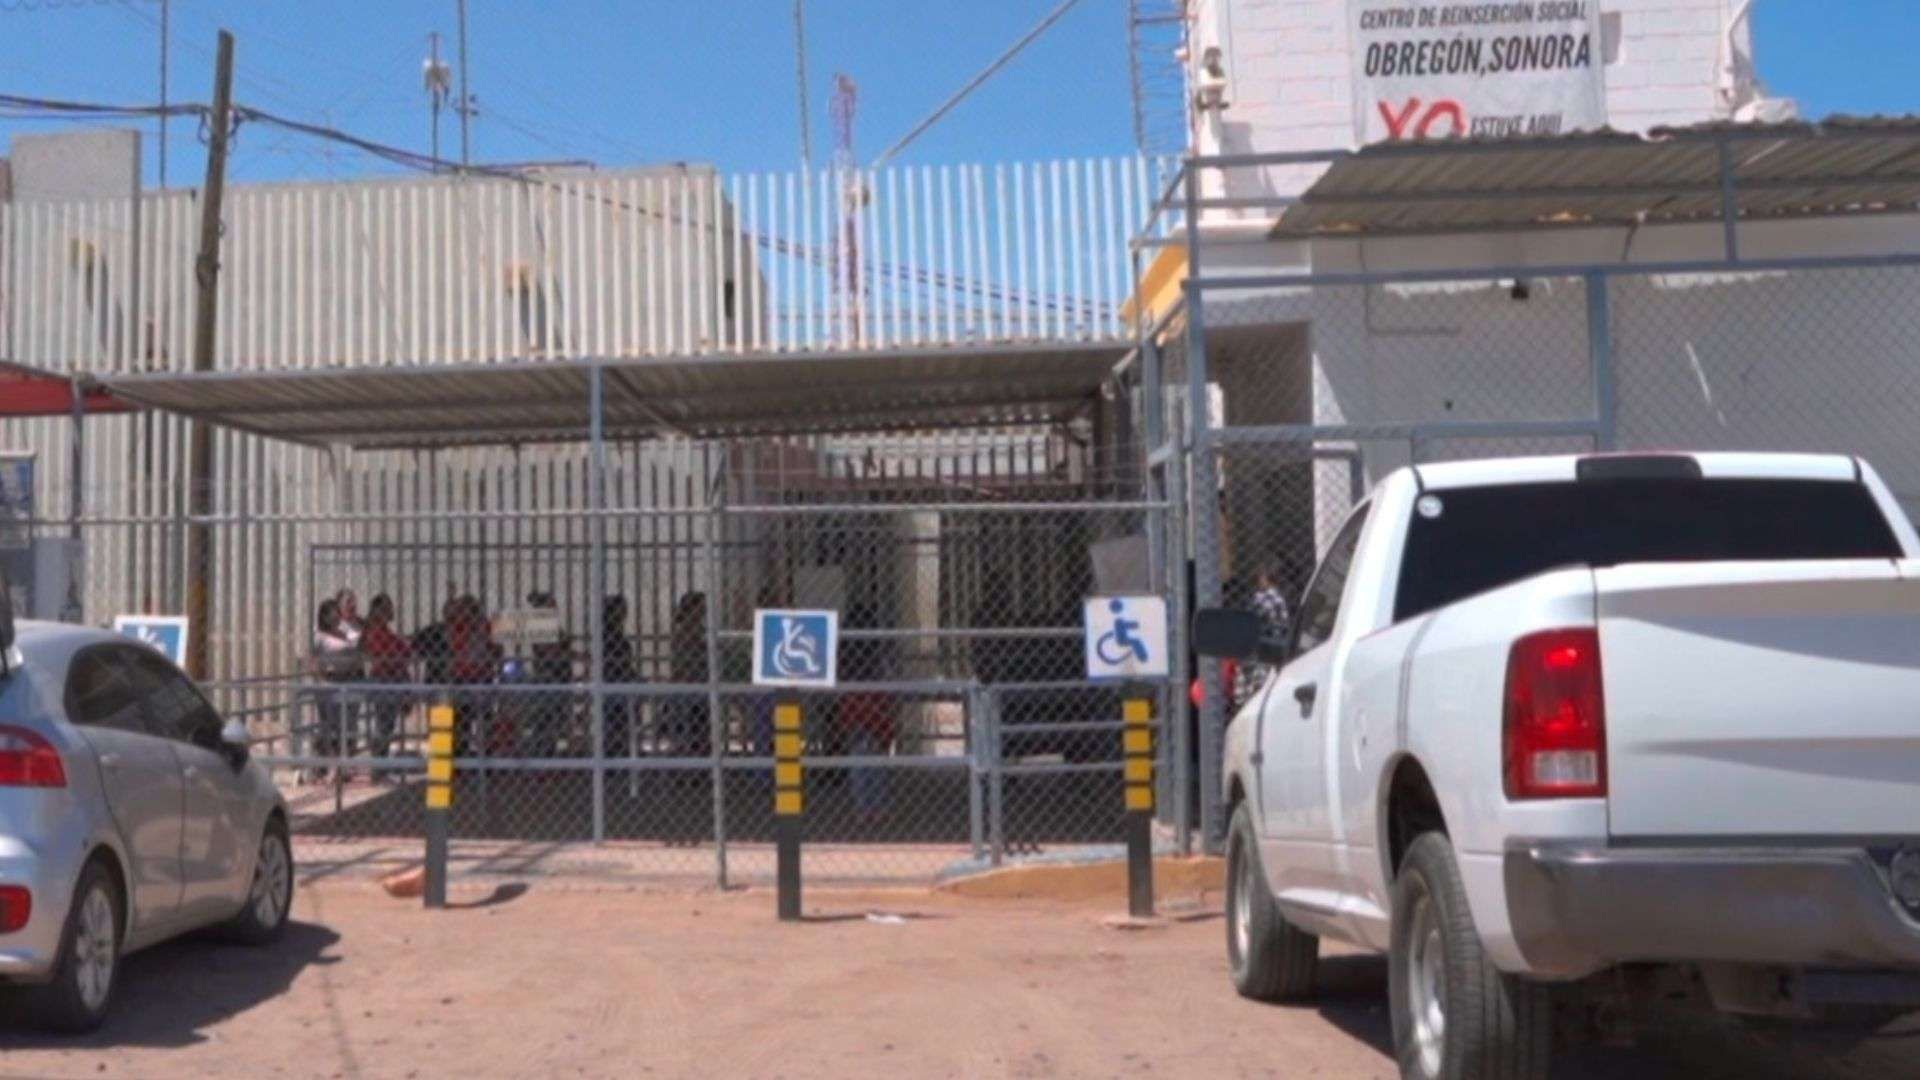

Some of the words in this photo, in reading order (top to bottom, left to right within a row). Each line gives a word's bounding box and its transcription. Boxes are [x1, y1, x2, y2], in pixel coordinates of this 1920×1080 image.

[1360, 9, 1415, 29] CENTRO
[1418, 6, 1437, 27] DE
[1537, 0, 1586, 22] SOCIAL
